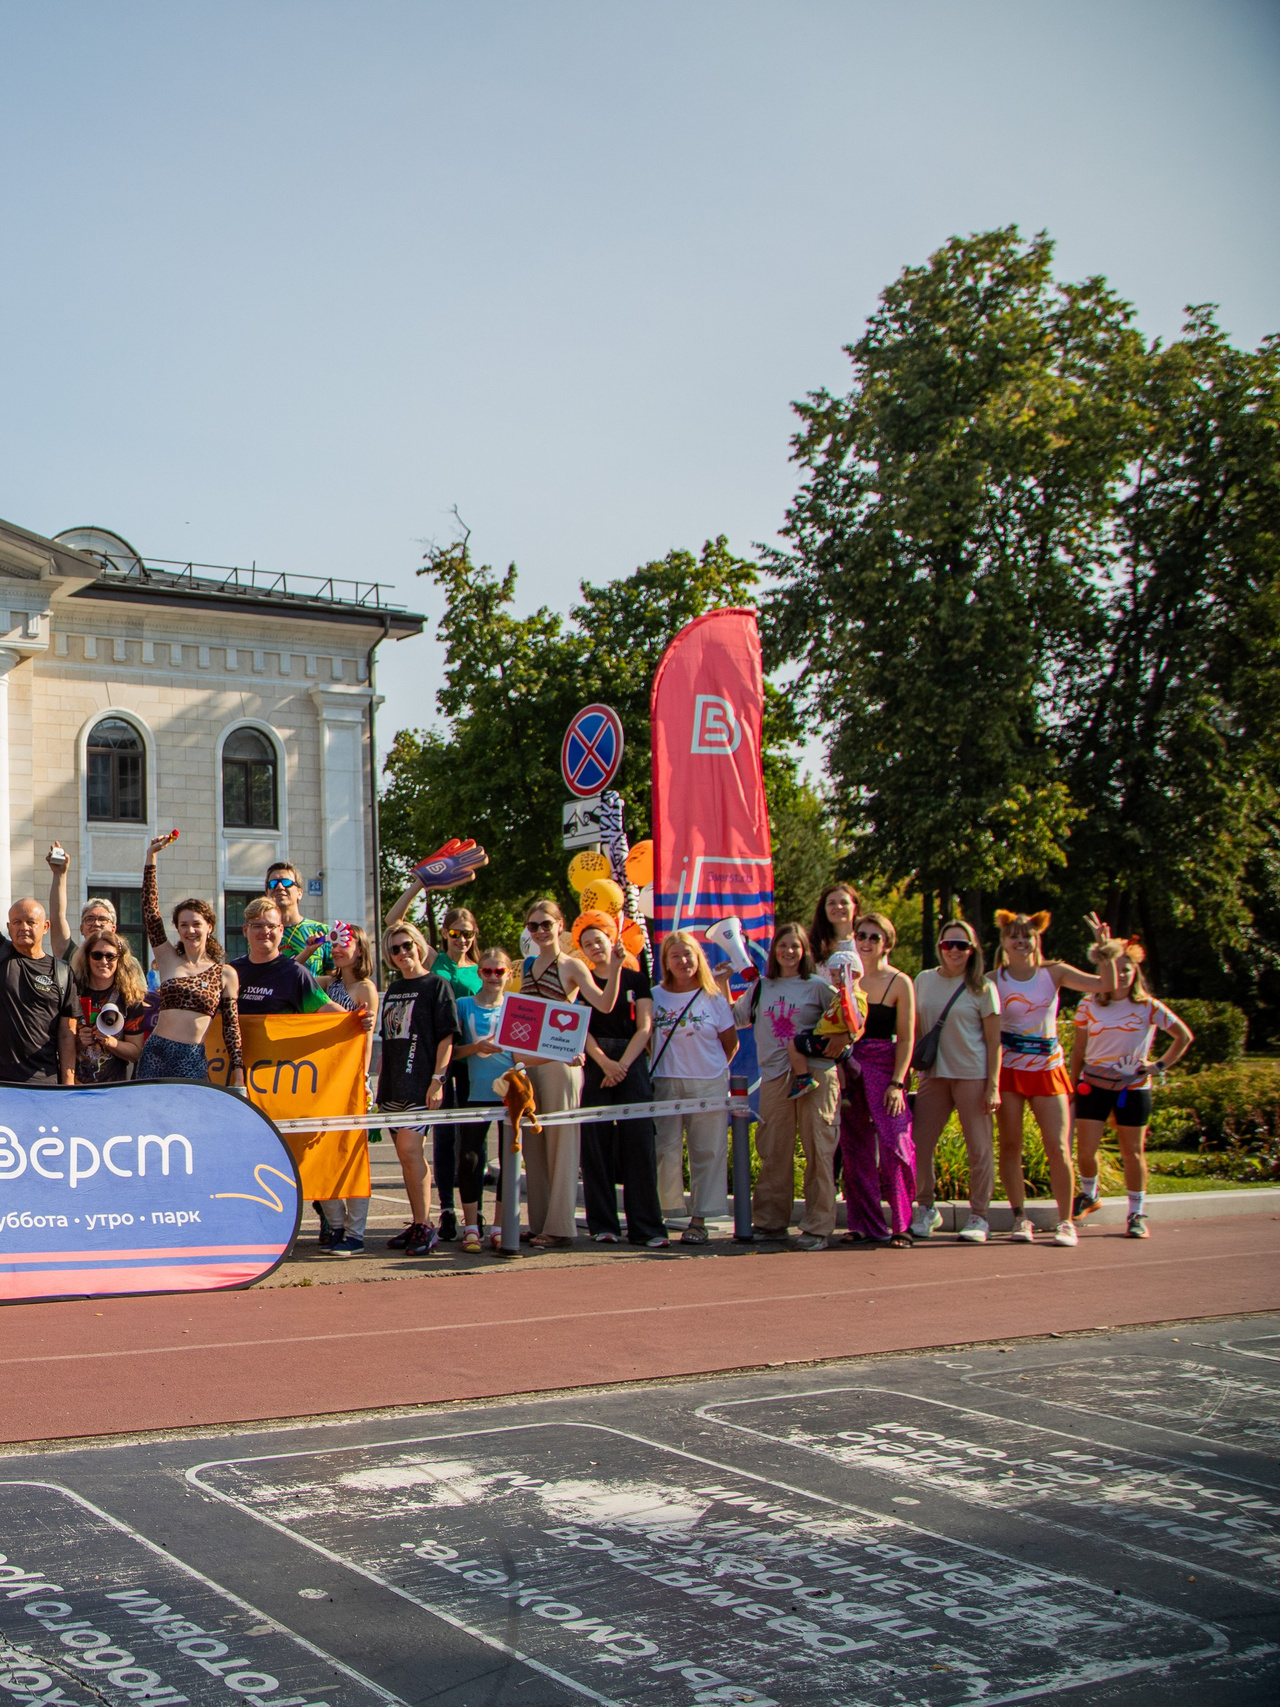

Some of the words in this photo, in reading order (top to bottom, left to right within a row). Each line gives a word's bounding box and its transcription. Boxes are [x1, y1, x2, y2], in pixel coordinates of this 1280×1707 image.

[311, 881, 320, 890] 24
[707, 871, 754, 883] 5verst.ru
[85, 1211, 134, 1231] утро
[152, 1208, 202, 1227] парк
[866, 1421, 1102, 1486] беговой
[398, 1538, 662, 1656] сможете:
[540, 1525, 877, 1653] размяться
